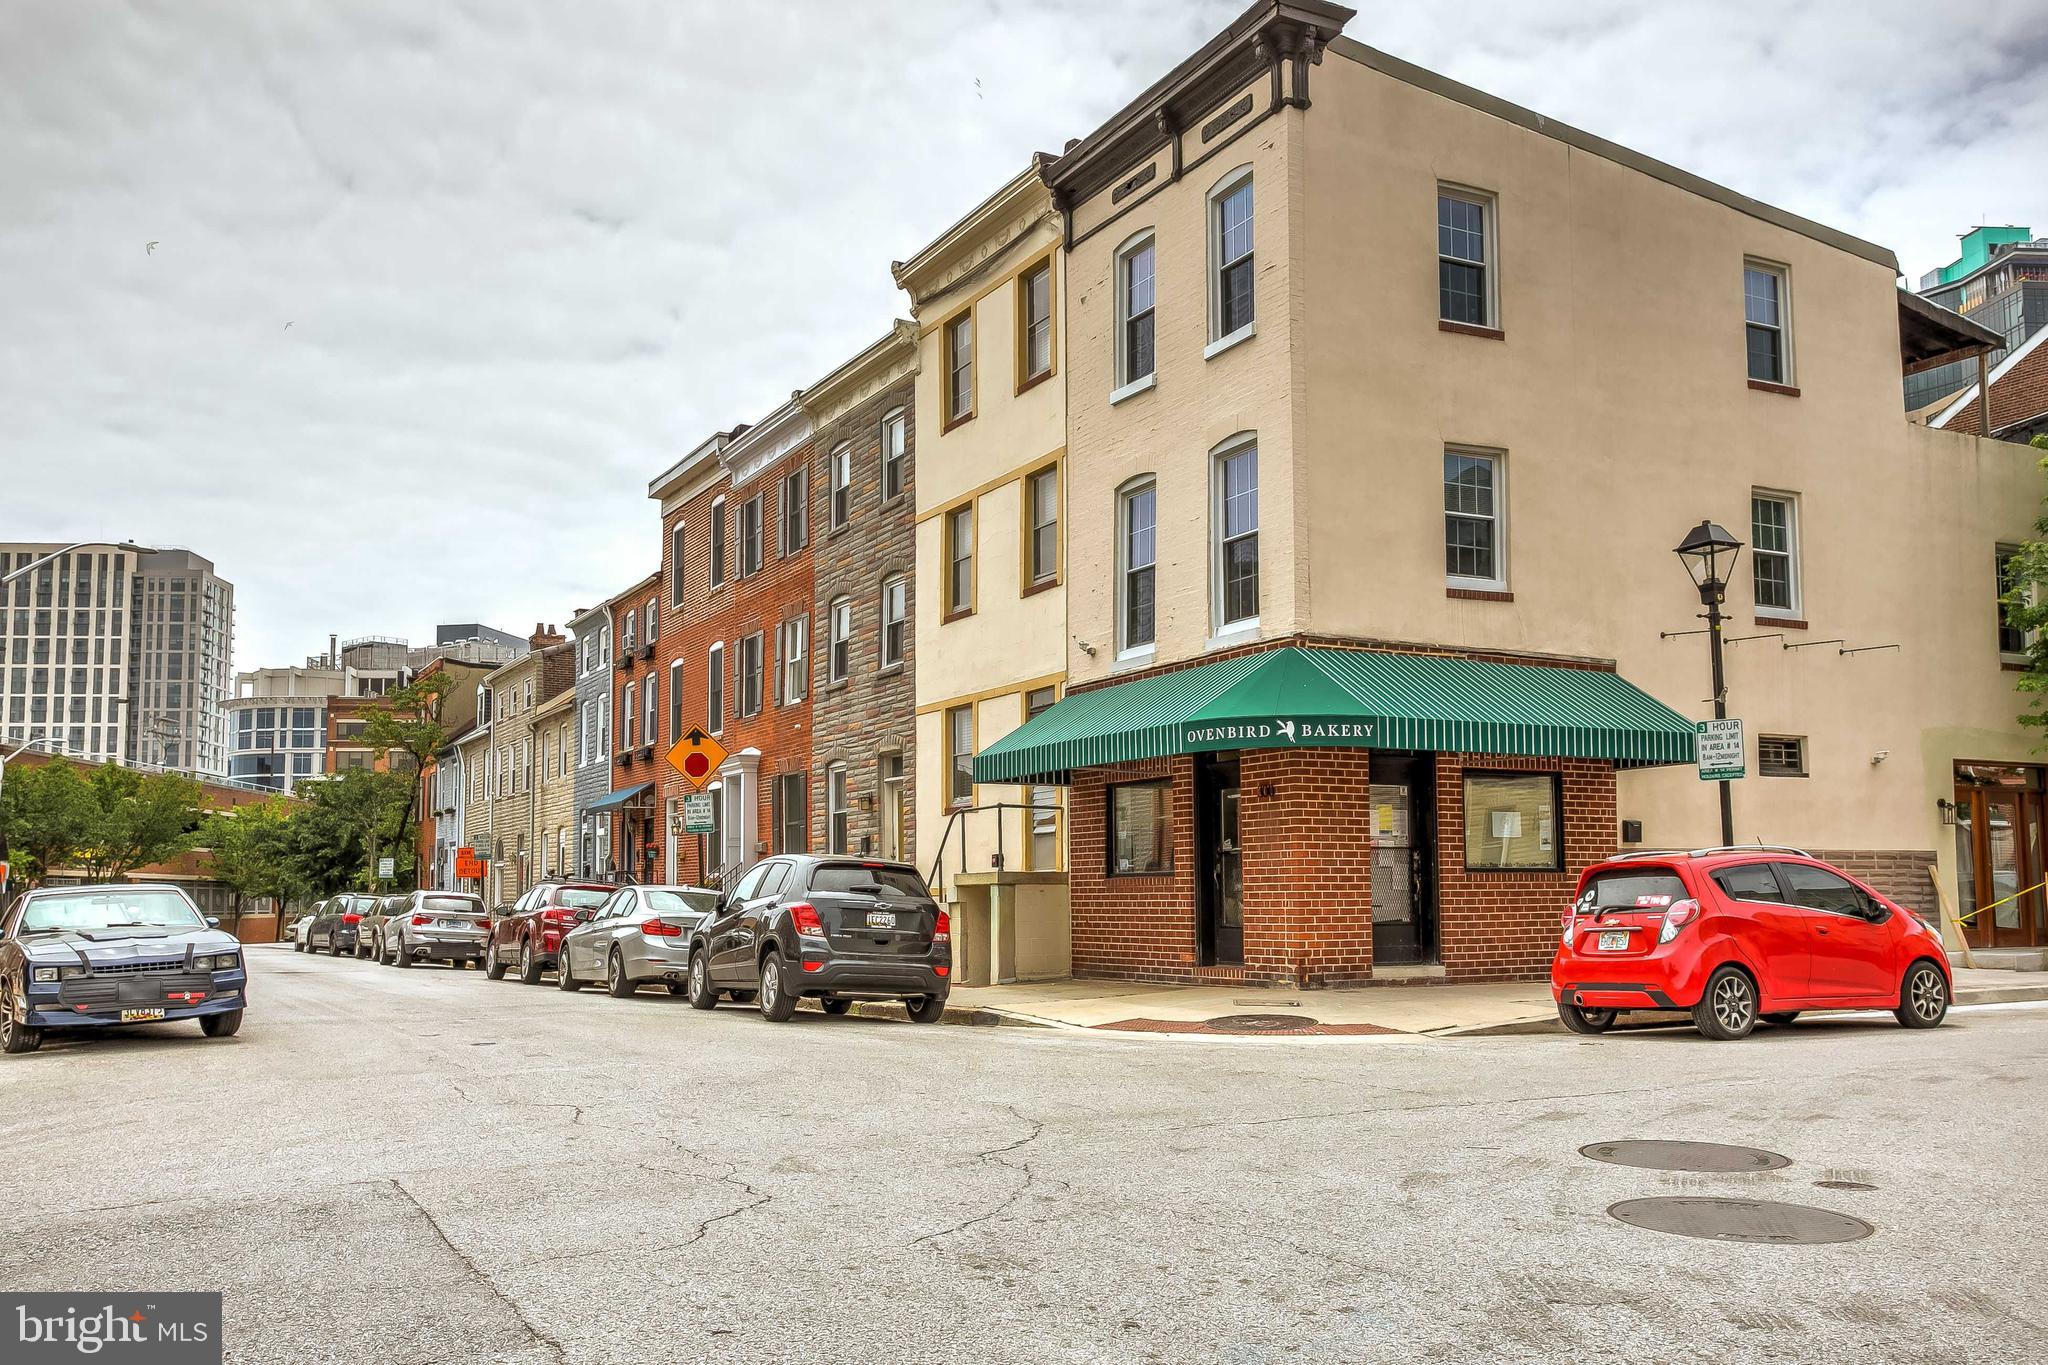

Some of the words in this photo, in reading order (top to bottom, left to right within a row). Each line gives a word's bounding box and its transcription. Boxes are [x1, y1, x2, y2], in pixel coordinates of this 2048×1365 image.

[1699, 723, 1706, 733] 3
[1712, 721, 1740, 731] HOUR
[1187, 725, 1271, 743] OVENBIRD
[1301, 724, 1375, 737] BAKERY
[1701, 733, 1723, 742] PARKING
[1726, 732, 1739, 740] LIMIT
[1710, 742, 1725, 751] AREA
[1734, 741, 1740, 749] 14
